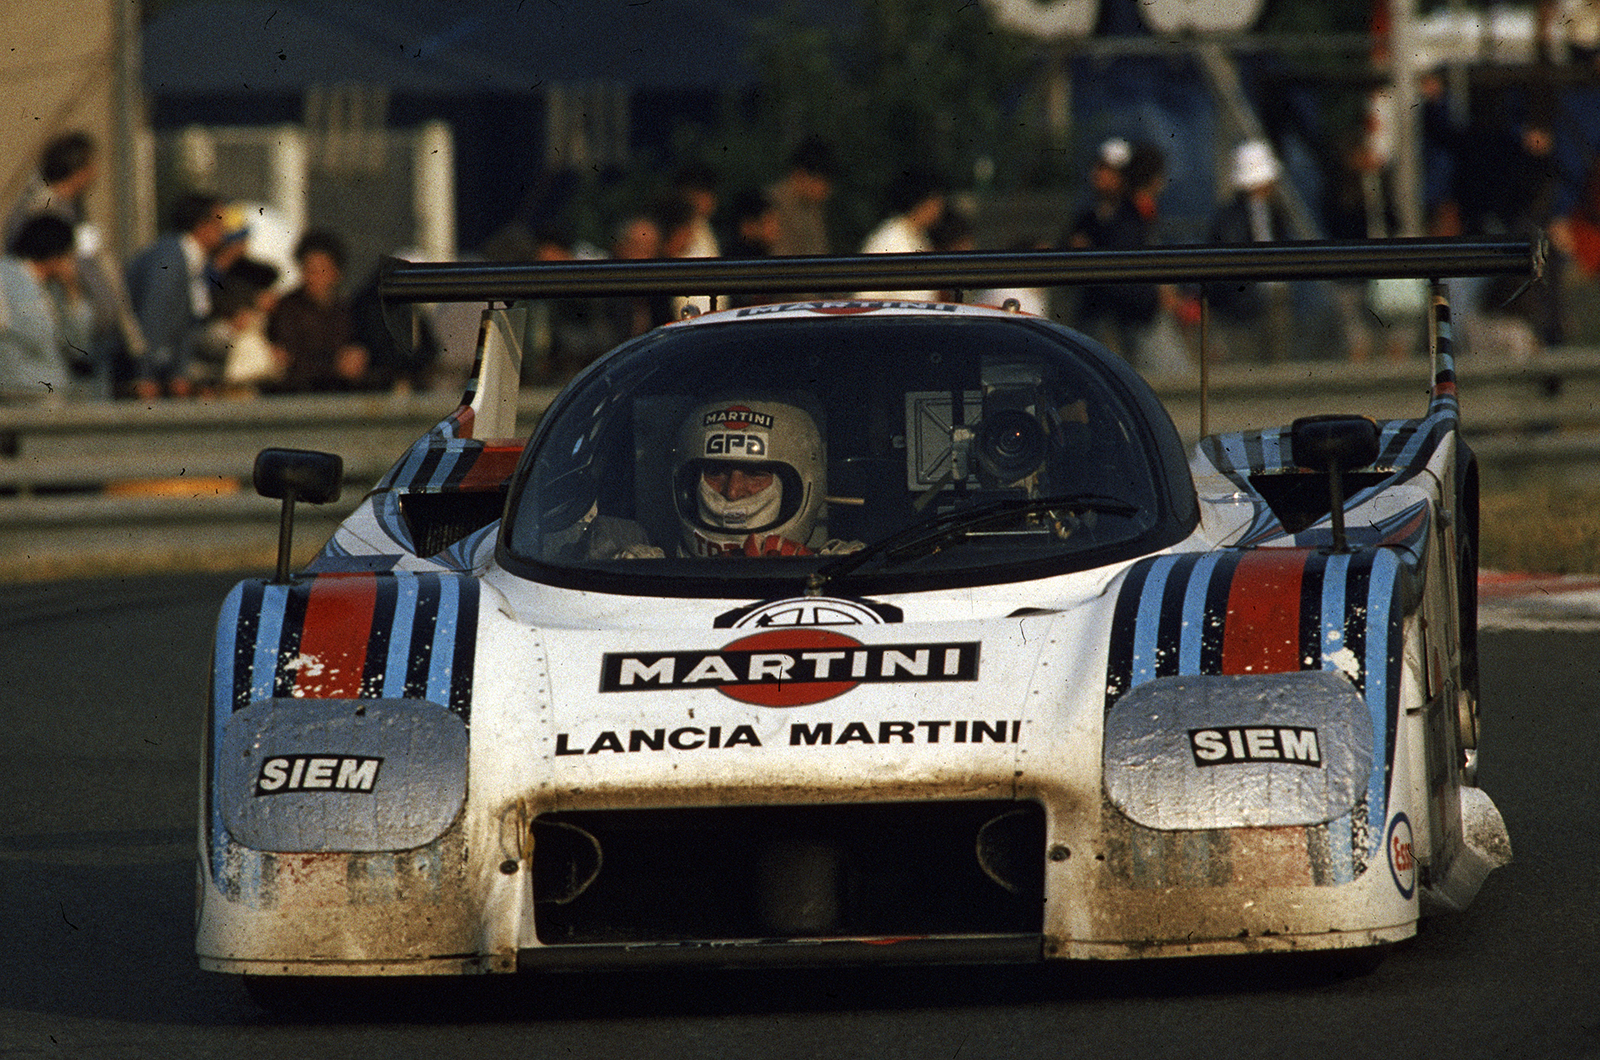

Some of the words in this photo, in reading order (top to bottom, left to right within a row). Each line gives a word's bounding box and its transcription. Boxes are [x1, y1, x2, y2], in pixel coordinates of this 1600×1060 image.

[705, 411, 771, 425] MARTINI
[619, 647, 961, 686] MARTINI
[555, 725, 761, 756] LANCIA
[790, 720, 1022, 747] MARTINI
[1193, 729, 1320, 761] SIEM
[259, 758, 379, 791] SIEM
